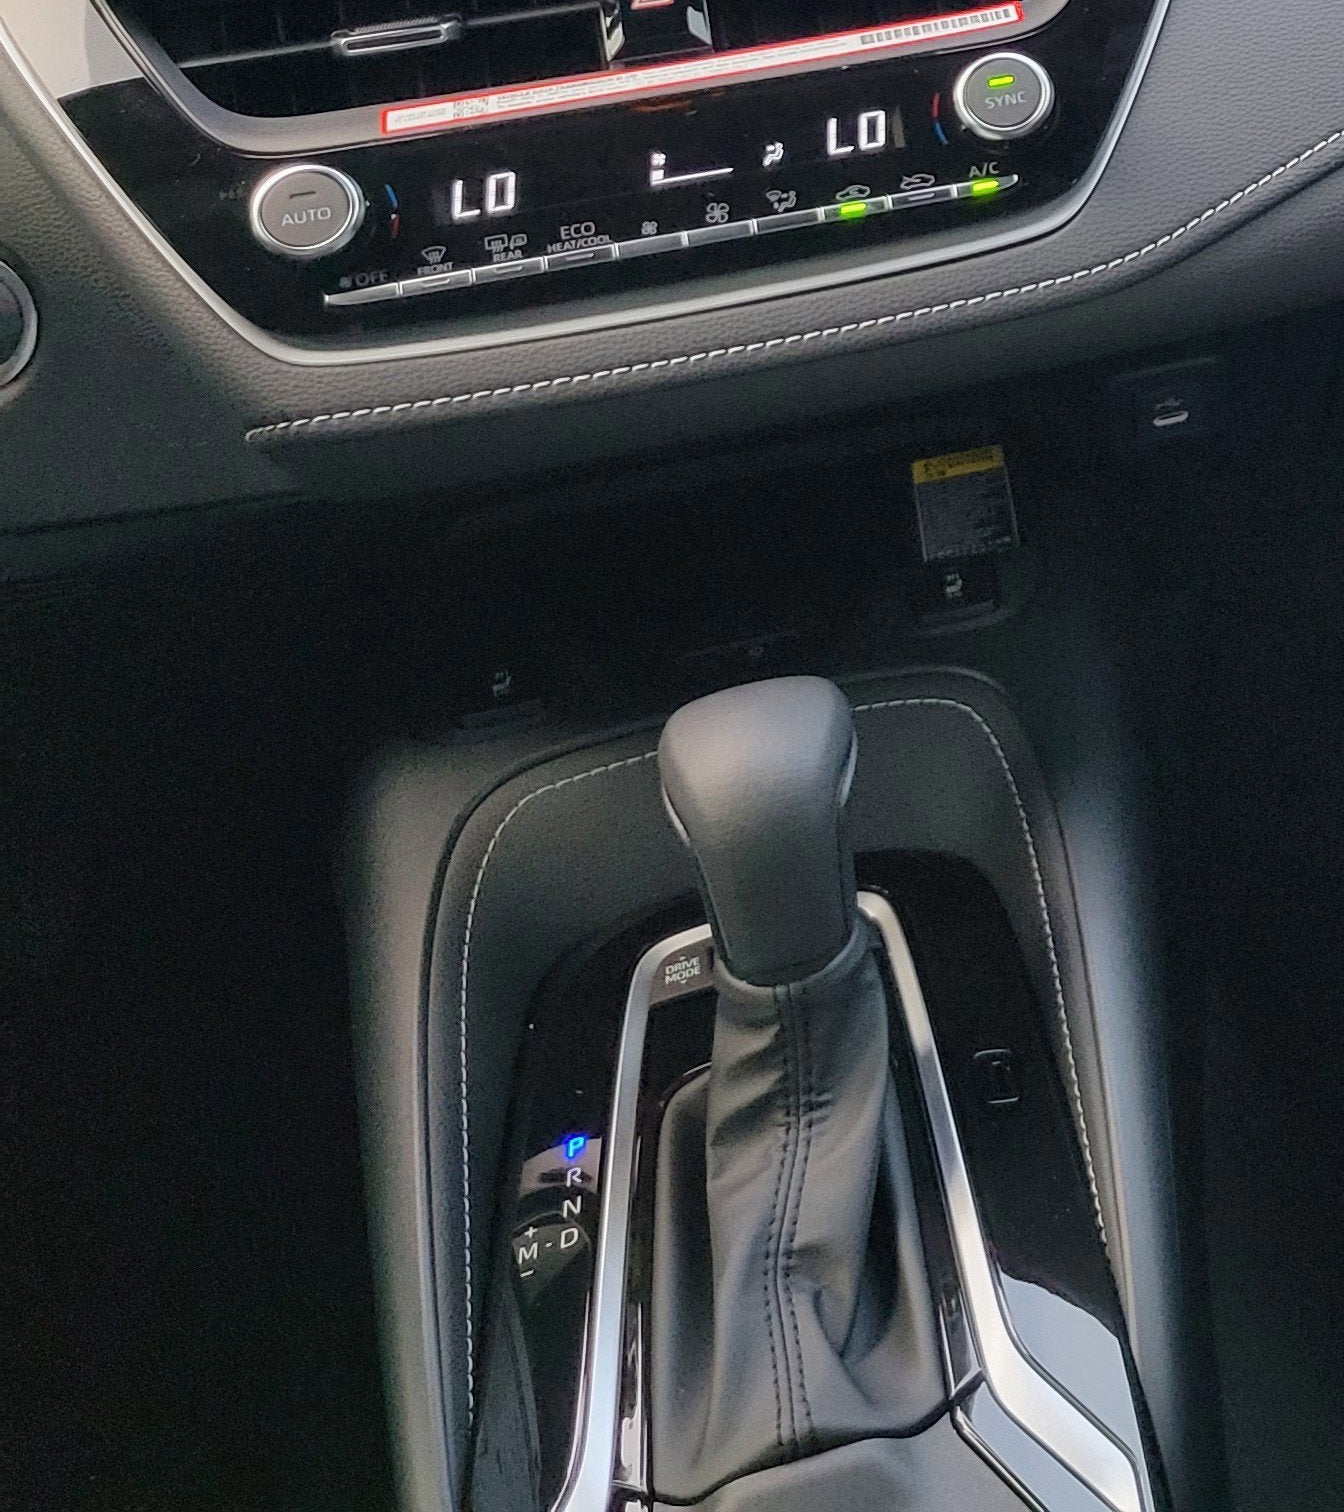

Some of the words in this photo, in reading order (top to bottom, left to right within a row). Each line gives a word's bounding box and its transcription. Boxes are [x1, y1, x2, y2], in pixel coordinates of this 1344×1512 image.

[984, 90, 1027, 110] SYNC
[969, 161, 1001, 178] A/C
[281, 206, 332, 227] AUTO
[560, 221, 597, 240] ECO
[547, 234, 612, 254] HEAT/COOL
[492, 249, 523, 263] REAR
[354, 269, 391, 288] OFF
[417, 261, 454, 276] FRONT
[665, 956, 700, 975] DRIVE
[665, 965, 701, 985] MODE
[567, 1136, 585, 1159] P
[565, 1167, 583, 1188] R
[562, 1195, 582, 1218] N
[518, 1241, 539, 1265] M
[560, 1227, 579, 1249] D
